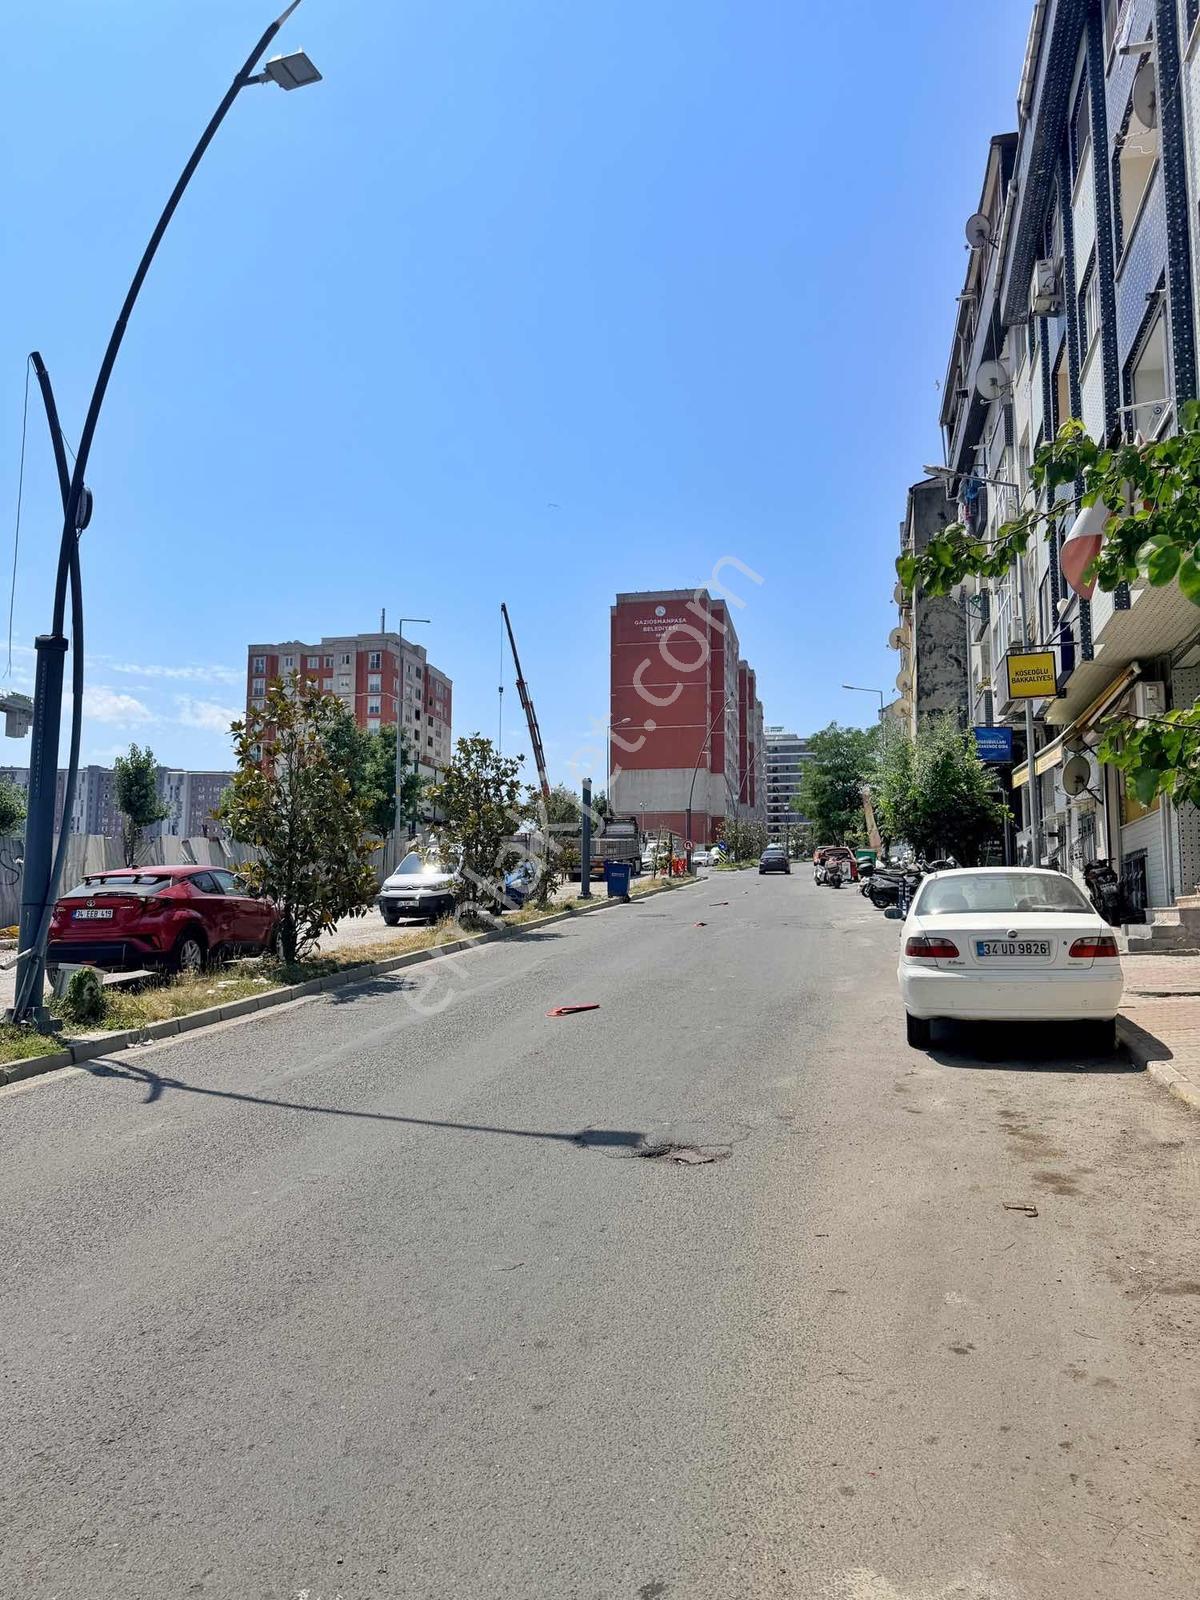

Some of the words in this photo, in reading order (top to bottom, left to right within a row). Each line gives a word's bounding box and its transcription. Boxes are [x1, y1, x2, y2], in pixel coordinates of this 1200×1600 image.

[984, 943, 998, 955] 34
[1001, 943, 1015, 955] UD
[1018, 943, 1047, 955] 9826
